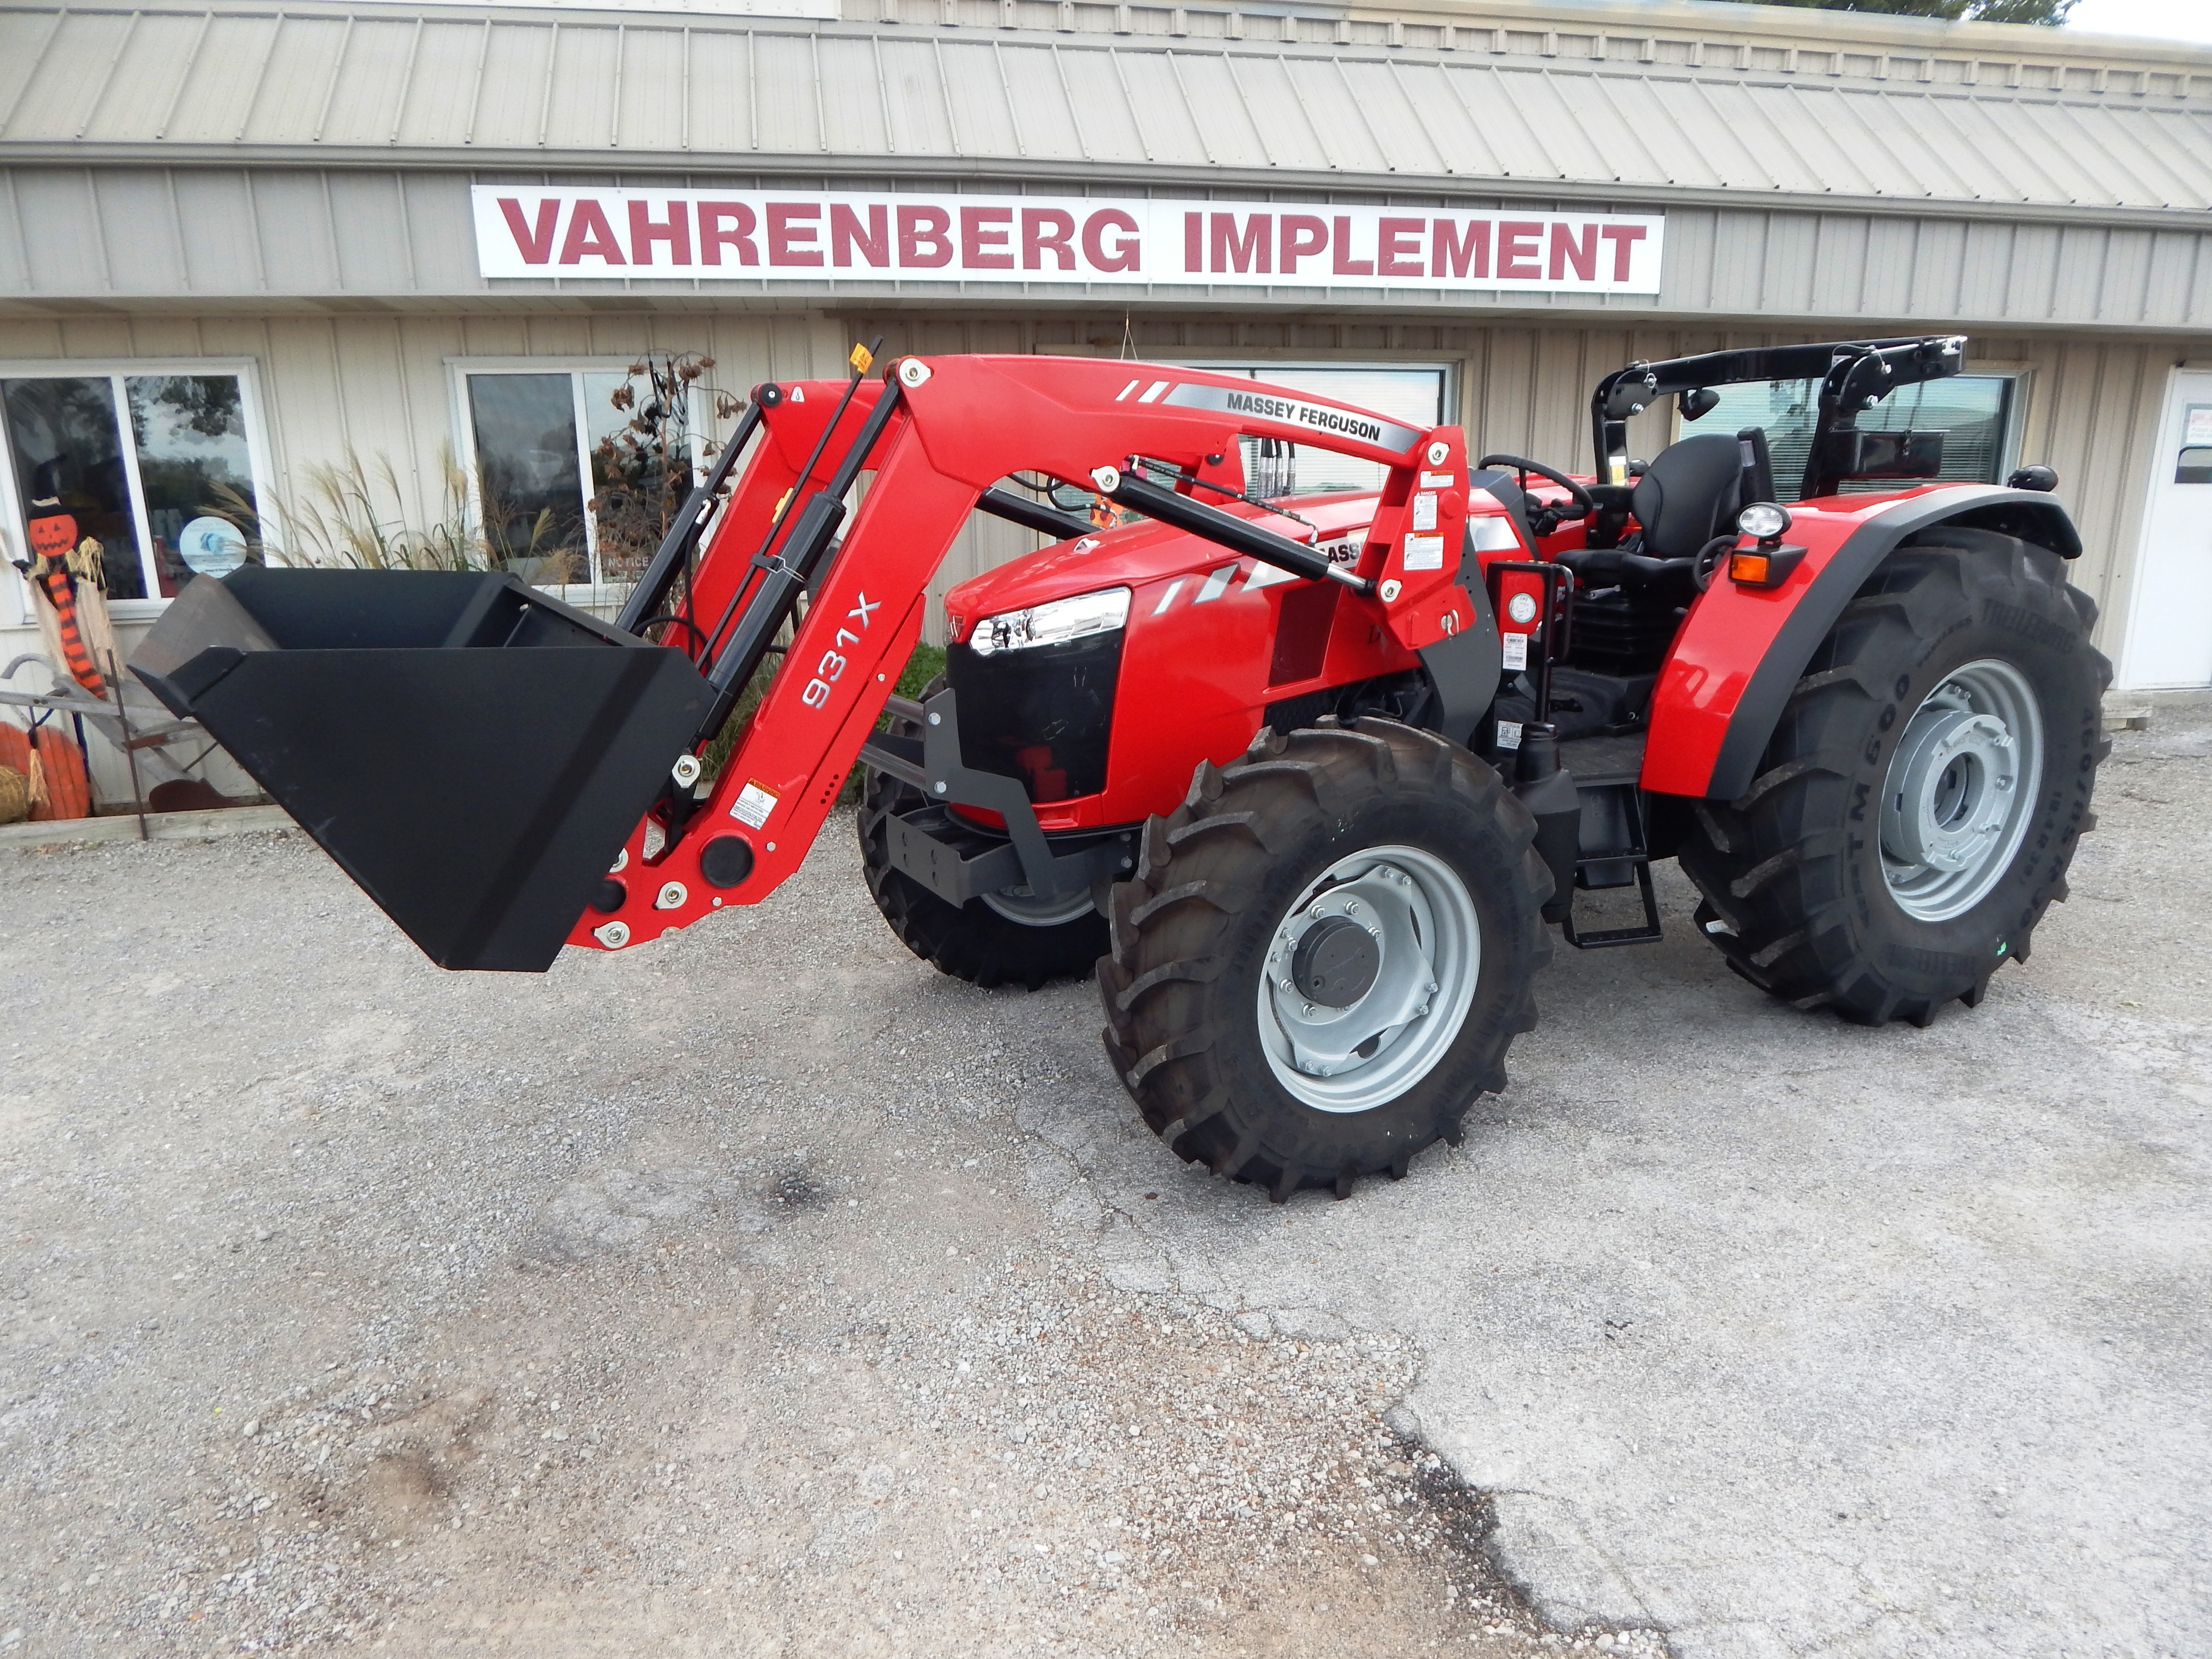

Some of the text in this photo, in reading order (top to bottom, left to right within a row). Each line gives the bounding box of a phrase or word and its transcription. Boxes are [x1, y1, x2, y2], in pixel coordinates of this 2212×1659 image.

[497, 197, 1647, 282] VAHRENBERG IMPLEMENT
[1227, 393, 1381, 441] MASSEY FERGUSON
[1319, 541, 1364, 564] ASS
[801, 590, 881, 710] 931X
